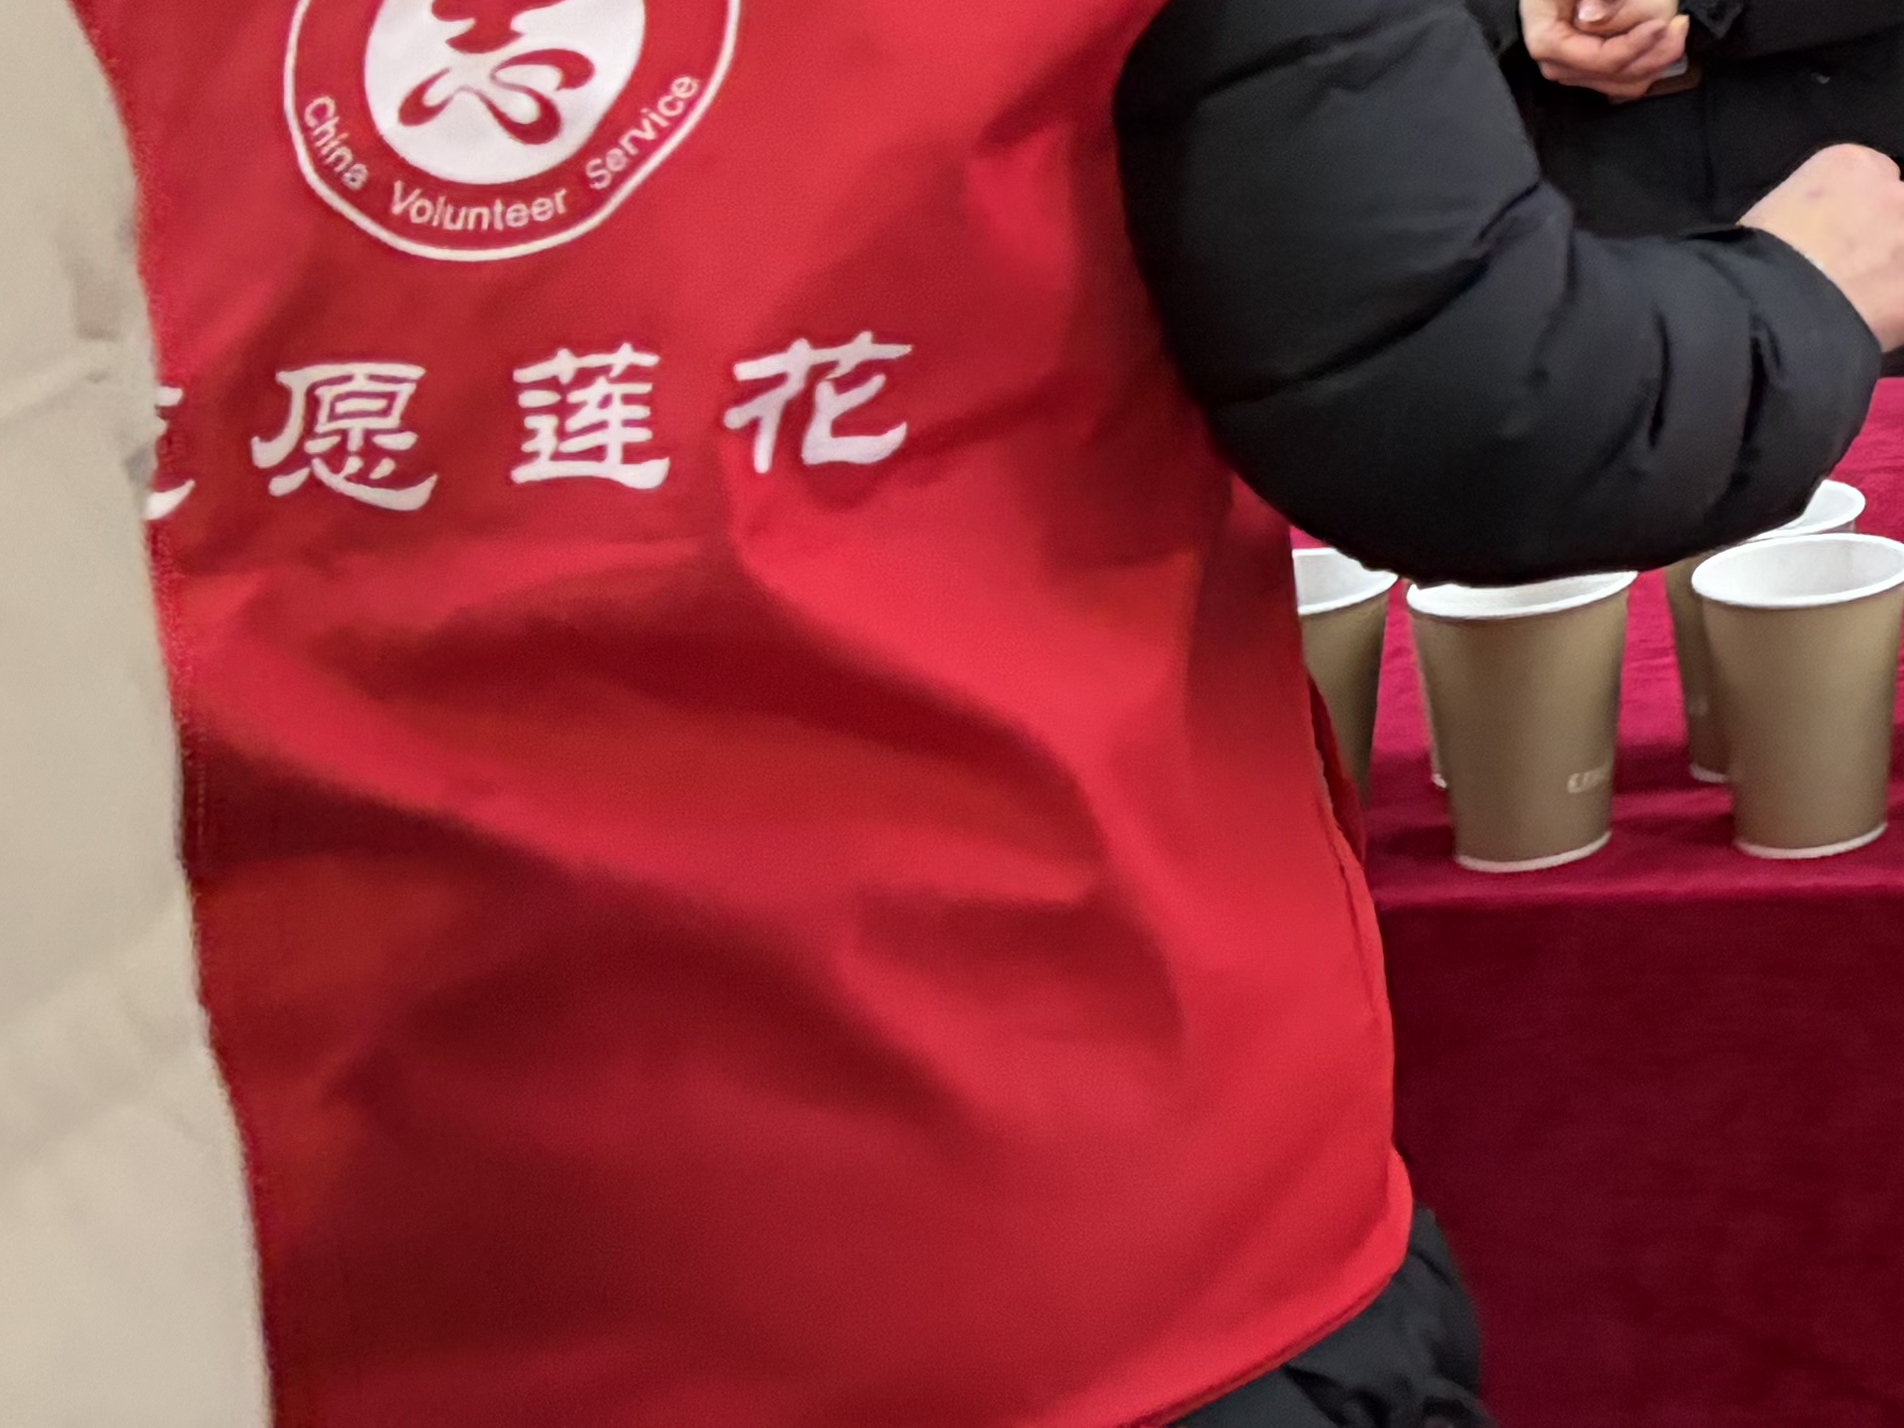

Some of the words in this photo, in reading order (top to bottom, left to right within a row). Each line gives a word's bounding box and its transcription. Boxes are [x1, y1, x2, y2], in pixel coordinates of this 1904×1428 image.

[303, 95, 369, 191] China
[389, 180, 568, 231] Volunteer
[584, 74, 699, 191] Service
